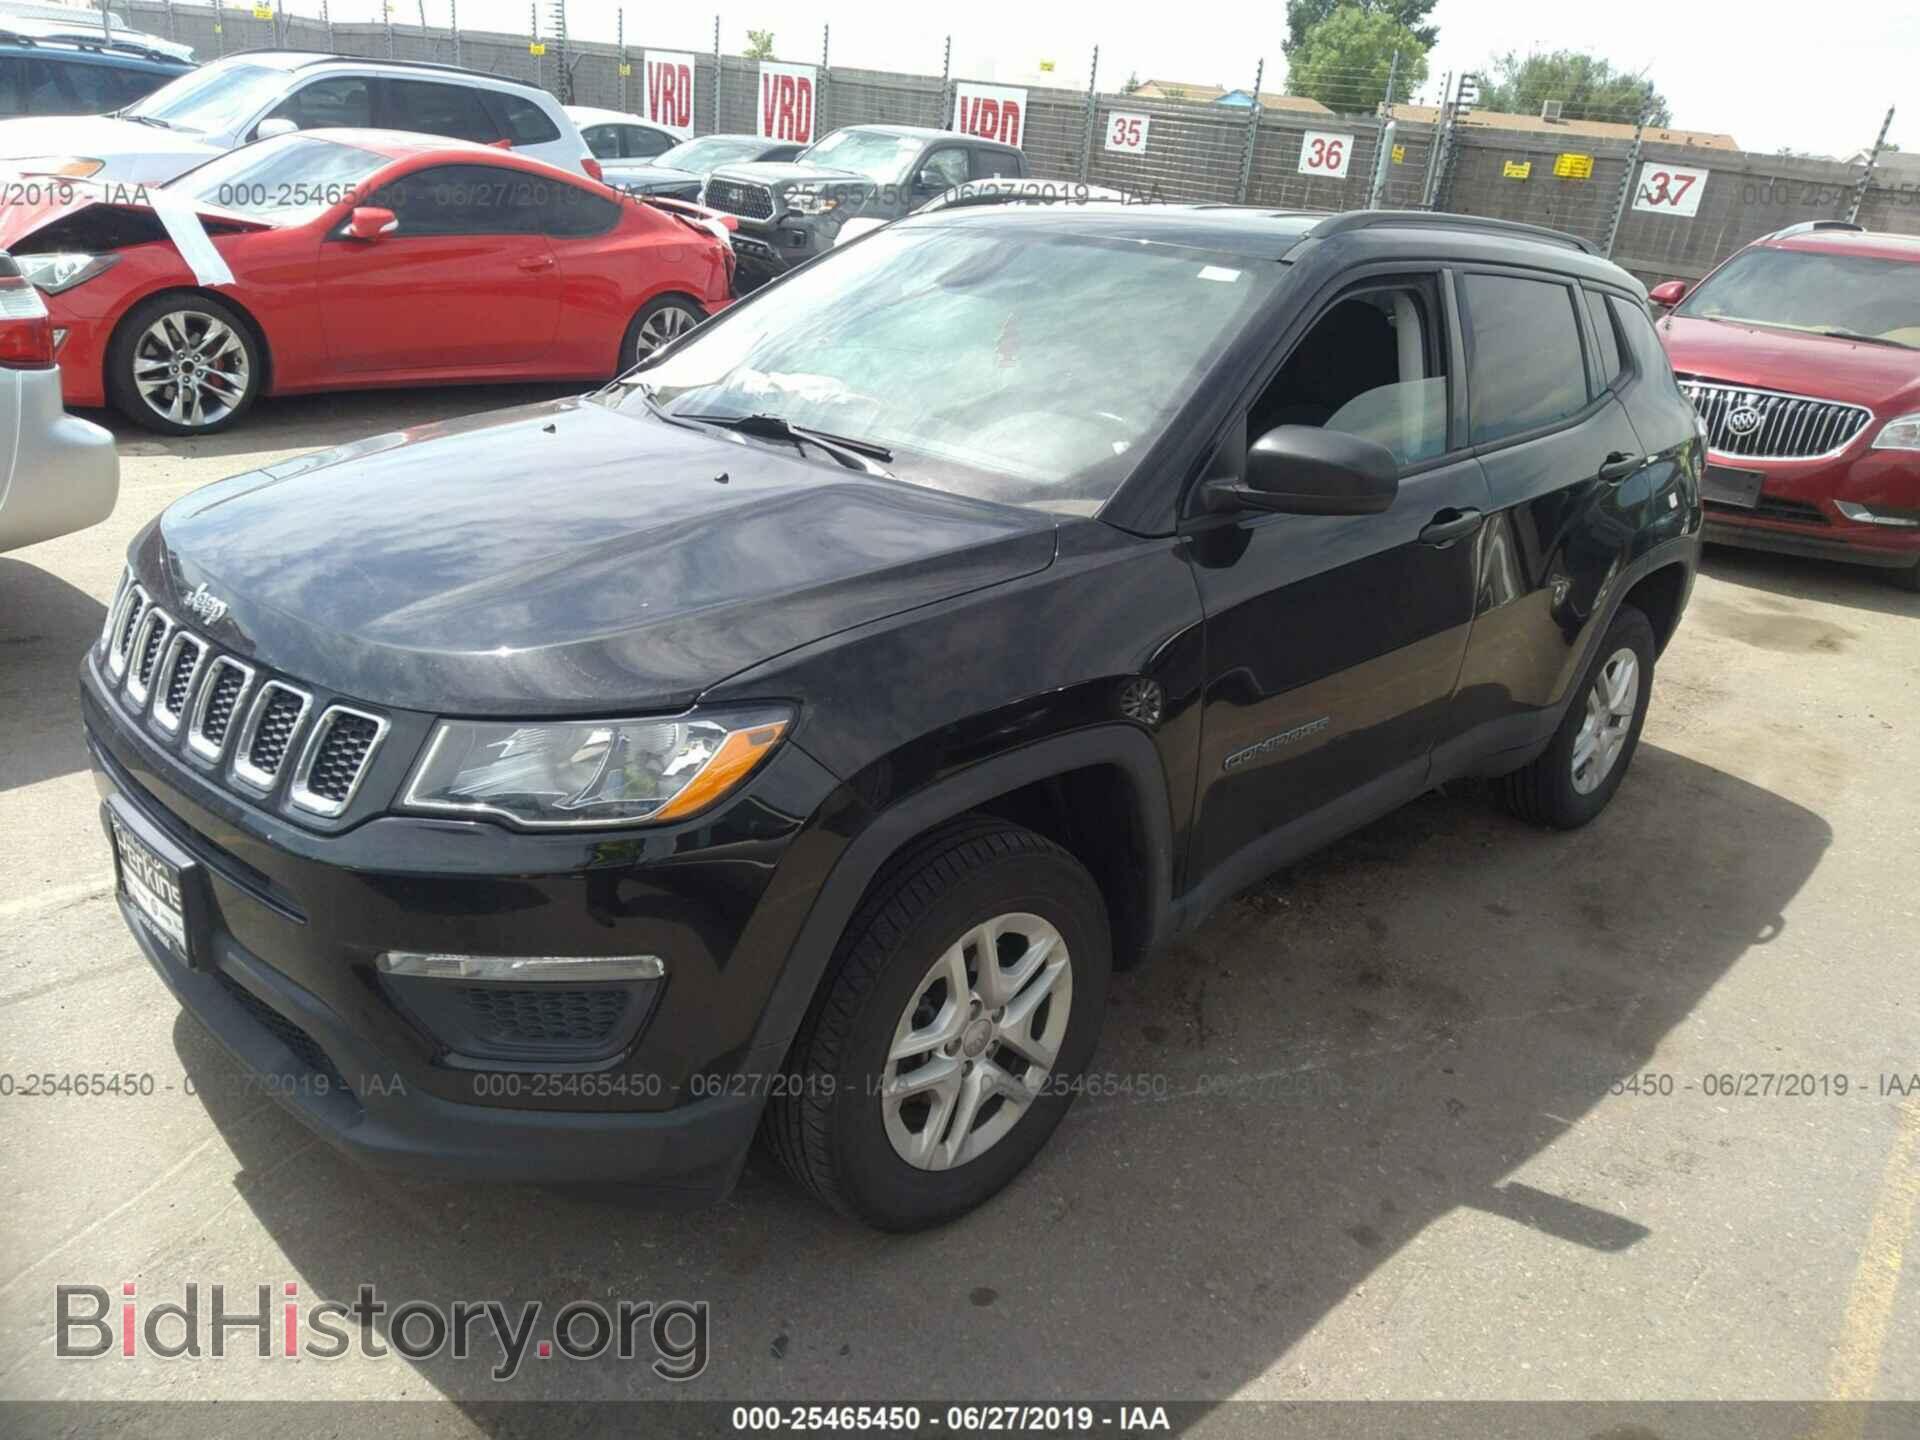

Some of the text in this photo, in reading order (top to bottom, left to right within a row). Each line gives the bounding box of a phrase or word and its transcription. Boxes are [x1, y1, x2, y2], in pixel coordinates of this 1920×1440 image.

[648, 61, 691, 127] VRD
[763, 73, 812, 144] VRD
[1113, 118, 1142, 146] 35
[1308, 138, 1343, 169] 36
[1647, 171, 1697, 206] 37
[183, 582, 227, 625] Jeep
